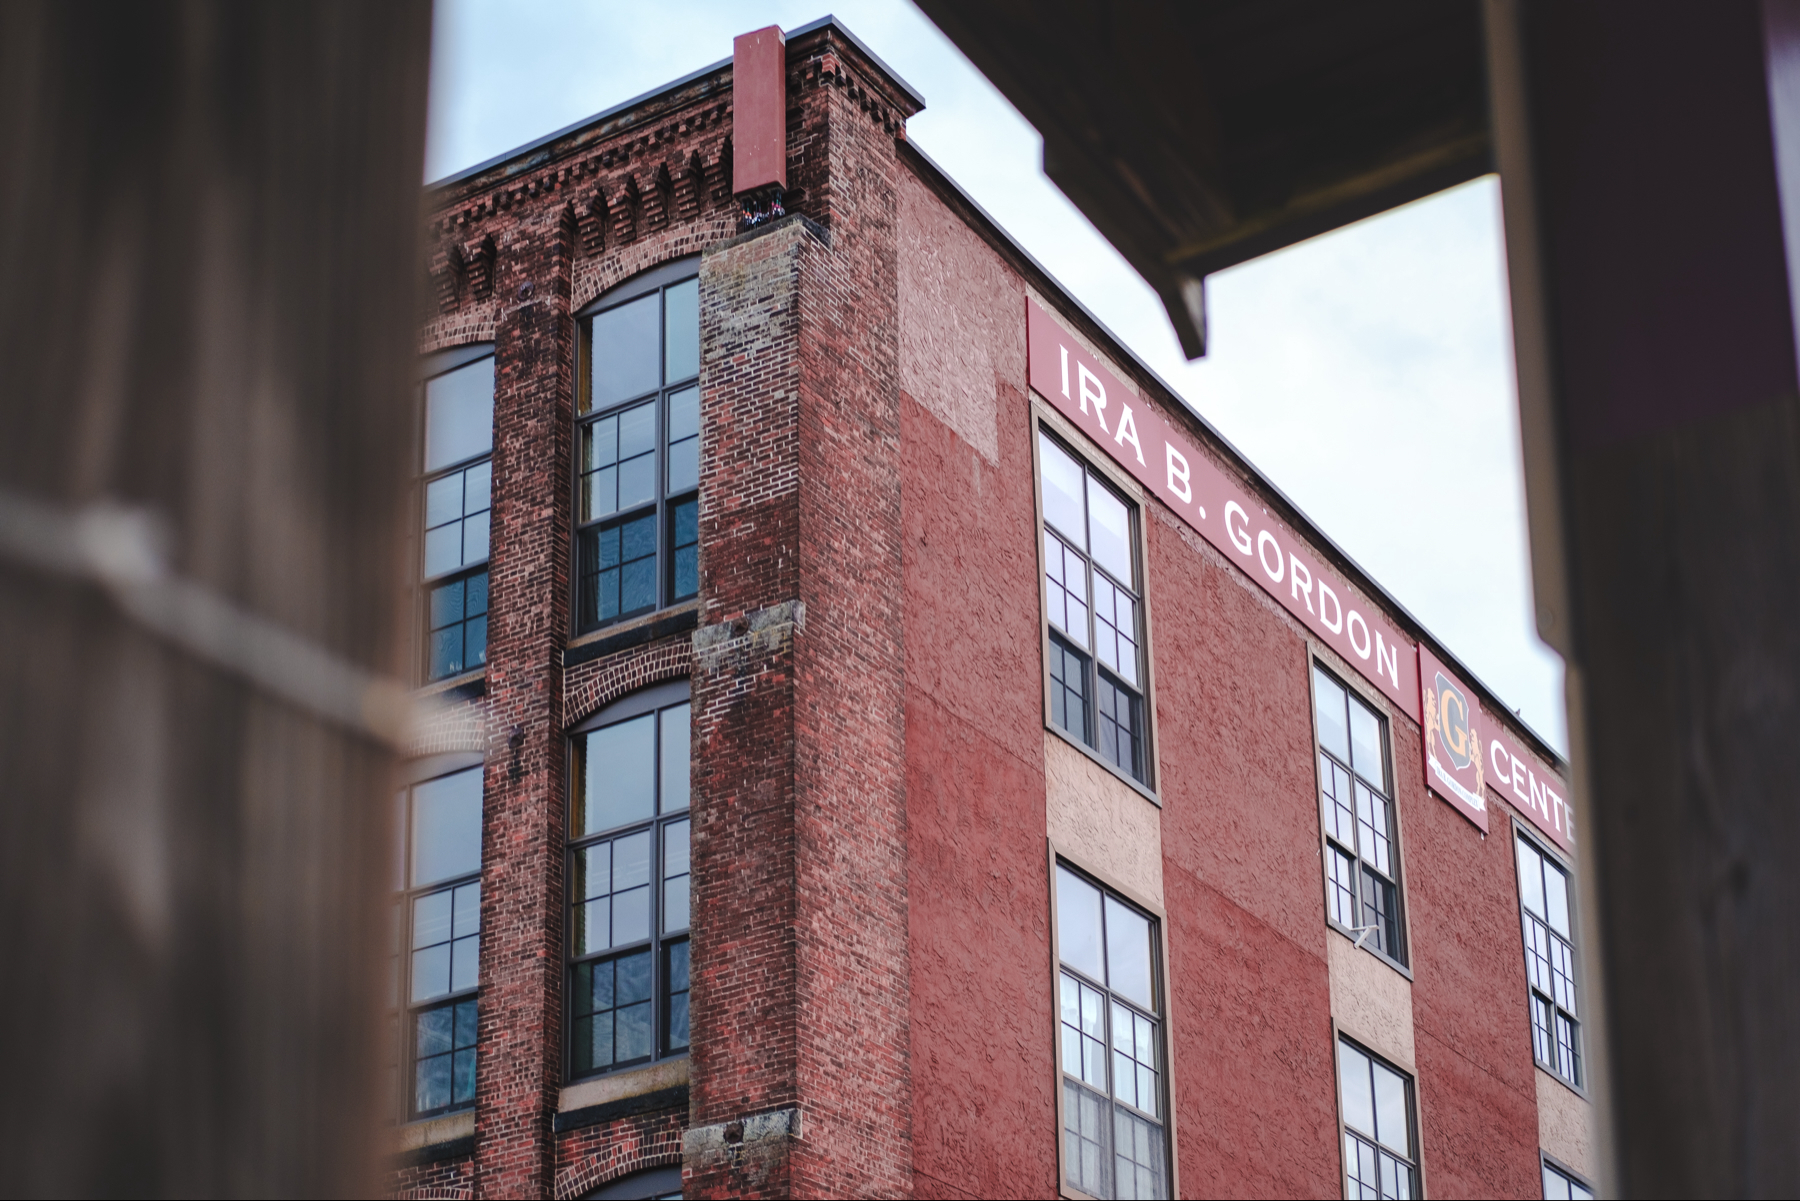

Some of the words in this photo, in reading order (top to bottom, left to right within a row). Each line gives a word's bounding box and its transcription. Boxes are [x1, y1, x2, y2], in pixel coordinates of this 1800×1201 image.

[1059, 343, 1147, 468] IRA
[1165, 440, 1207, 520] B.
[1224, 500, 1400, 691] GORDON
[1441, 689, 1468, 757] G
